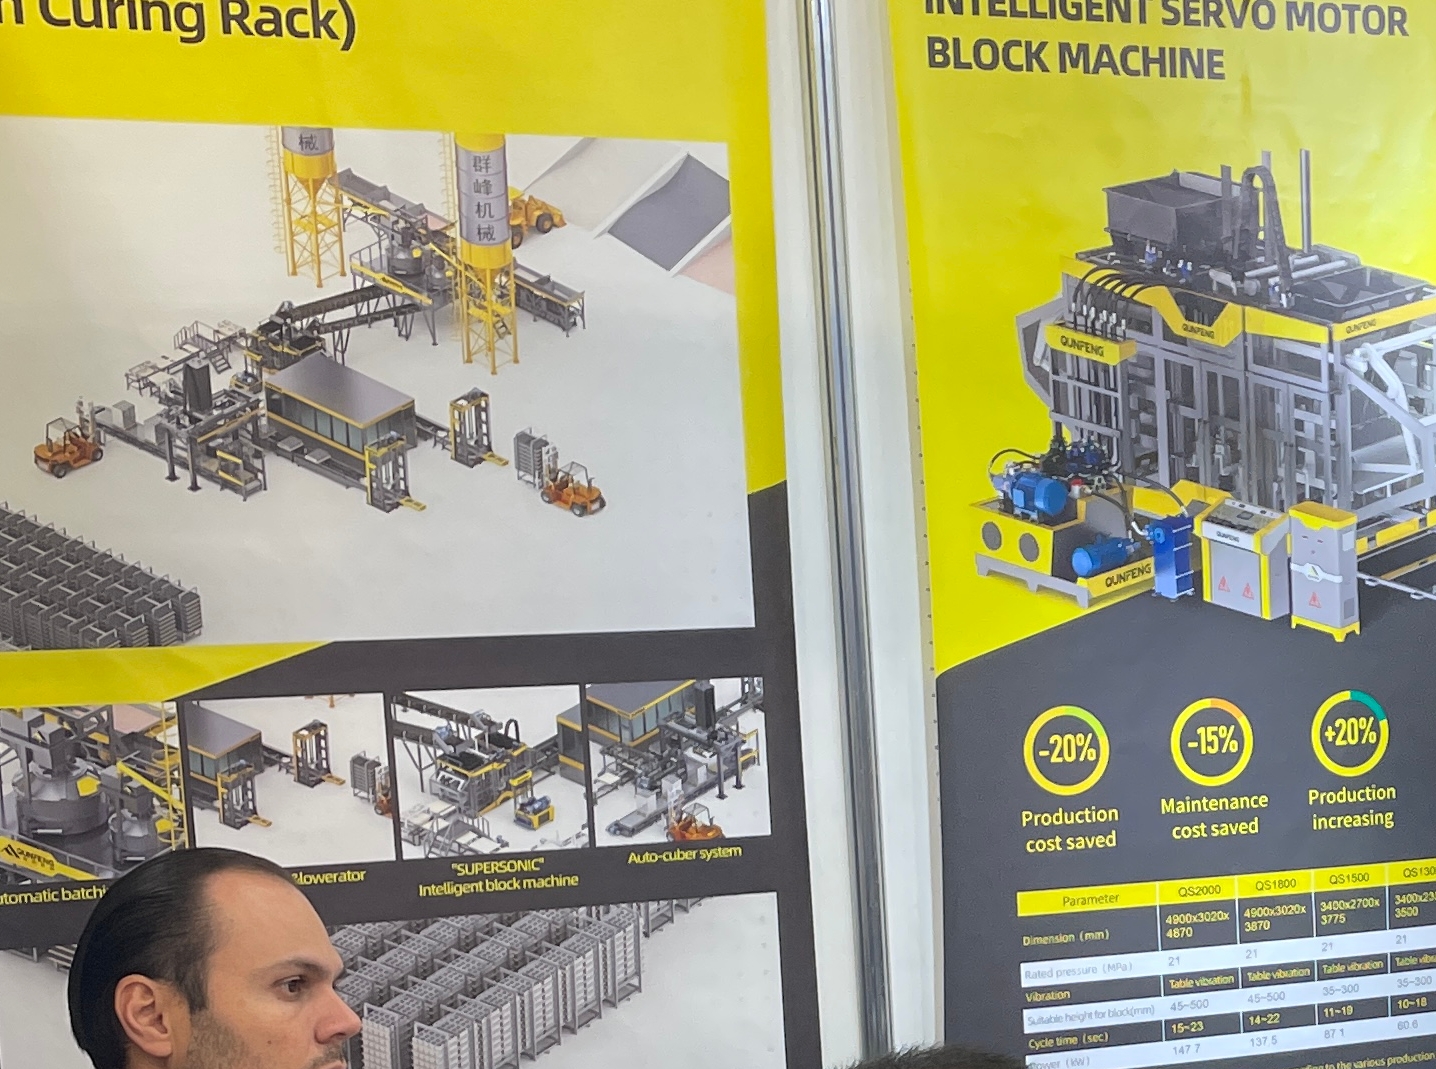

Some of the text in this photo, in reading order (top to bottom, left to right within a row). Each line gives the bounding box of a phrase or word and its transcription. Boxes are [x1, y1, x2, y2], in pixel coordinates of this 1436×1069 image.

[40, 0, 206, 43] Curing
[221, 0, 356, 51] Rack)
[1161, 0, 1276, 30] SERVO
[1286, 1, 1409, 36] MOTOR
[927, 36, 1226, 80] BLOCK MACHINE
[1060, 335, 1105, 358] QUNFENG
[1105, 563, 1152, 588] QUNFENG
[1187, 725, 1239, 755] -15%
[1324, 718, 1377, 746] +20%
[1038, 734, 1096, 763] -20%
[1160, 794, 1269, 815] Maintenance
[1308, 784, 1397, 806] Production
[1021, 805, 1119, 827] Production
[1312, 808, 1395, 831] increasing
[1172, 816, 1260, 840] cost saved
[1026, 830, 1117, 853] cost saved
[628, 846, 742, 865] Auto-cuber system
[419, 874, 579, 897] Intelligent block machine
[1063, 893, 1120, 907] Parameter
[1178, 884, 1221, 898] QS2000
[1255, 878, 1297, 891] QS1800
[1329, 872, 1370, 885] QS1500
[1320, 913, 1346, 925] 3775
[1022, 933, 1075, 947] Dimension
[1025, 968, 1053, 981] Rated
[1056, 964, 1097, 979] pressure
[1168, 956, 1181, 967] 21
[1245, 949, 1258, 959] 21
[1321, 942, 1334, 952] 21
[1396, 935, 1407, 945] 21
[1026, 990, 1071, 1003] Vibration
[1028, 1037, 1054, 1050] Cycle
[1056, 1035, 1078, 1047] time
